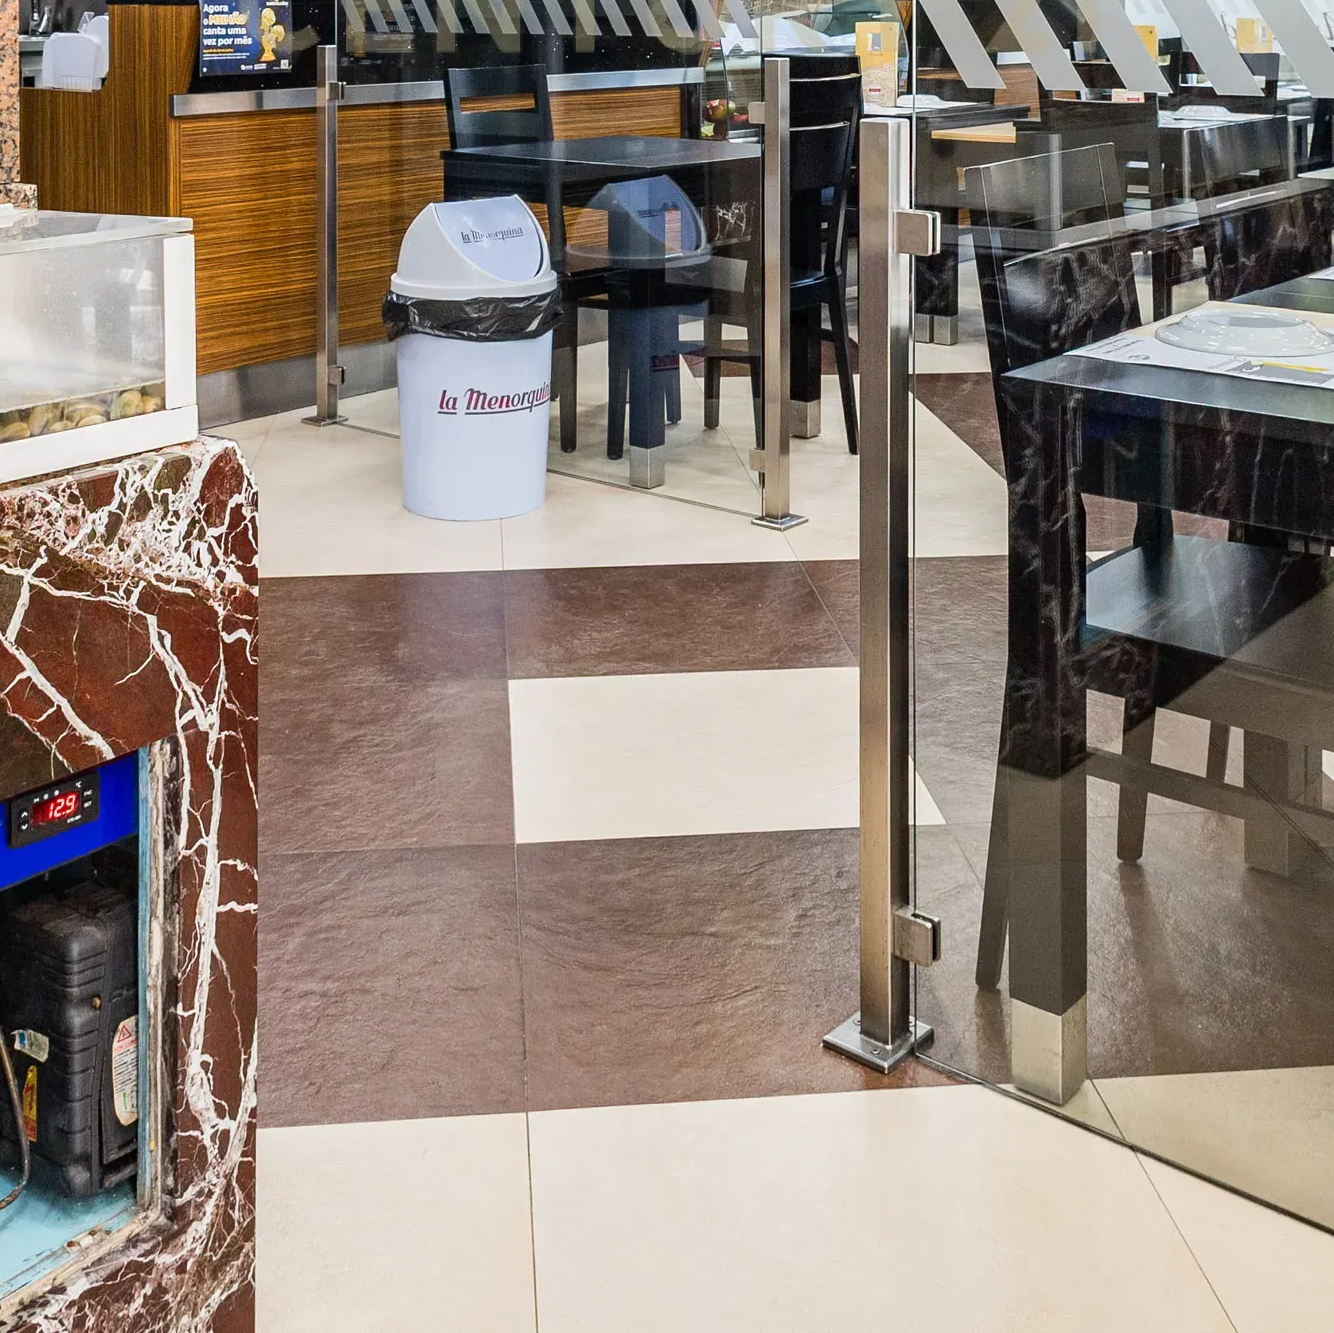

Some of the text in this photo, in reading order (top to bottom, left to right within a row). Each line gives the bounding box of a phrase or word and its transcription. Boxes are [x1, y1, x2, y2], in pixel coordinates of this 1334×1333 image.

[203, 3, 229, 14] Agora
[209, 11, 248, 25] MILHÃO
[203, 26, 247, 35] canta uma
[203, 35, 253, 47] vez por mês
[439, 382, 551, 414] la Menorquin
[48, 793, 76, 819] 12.9
